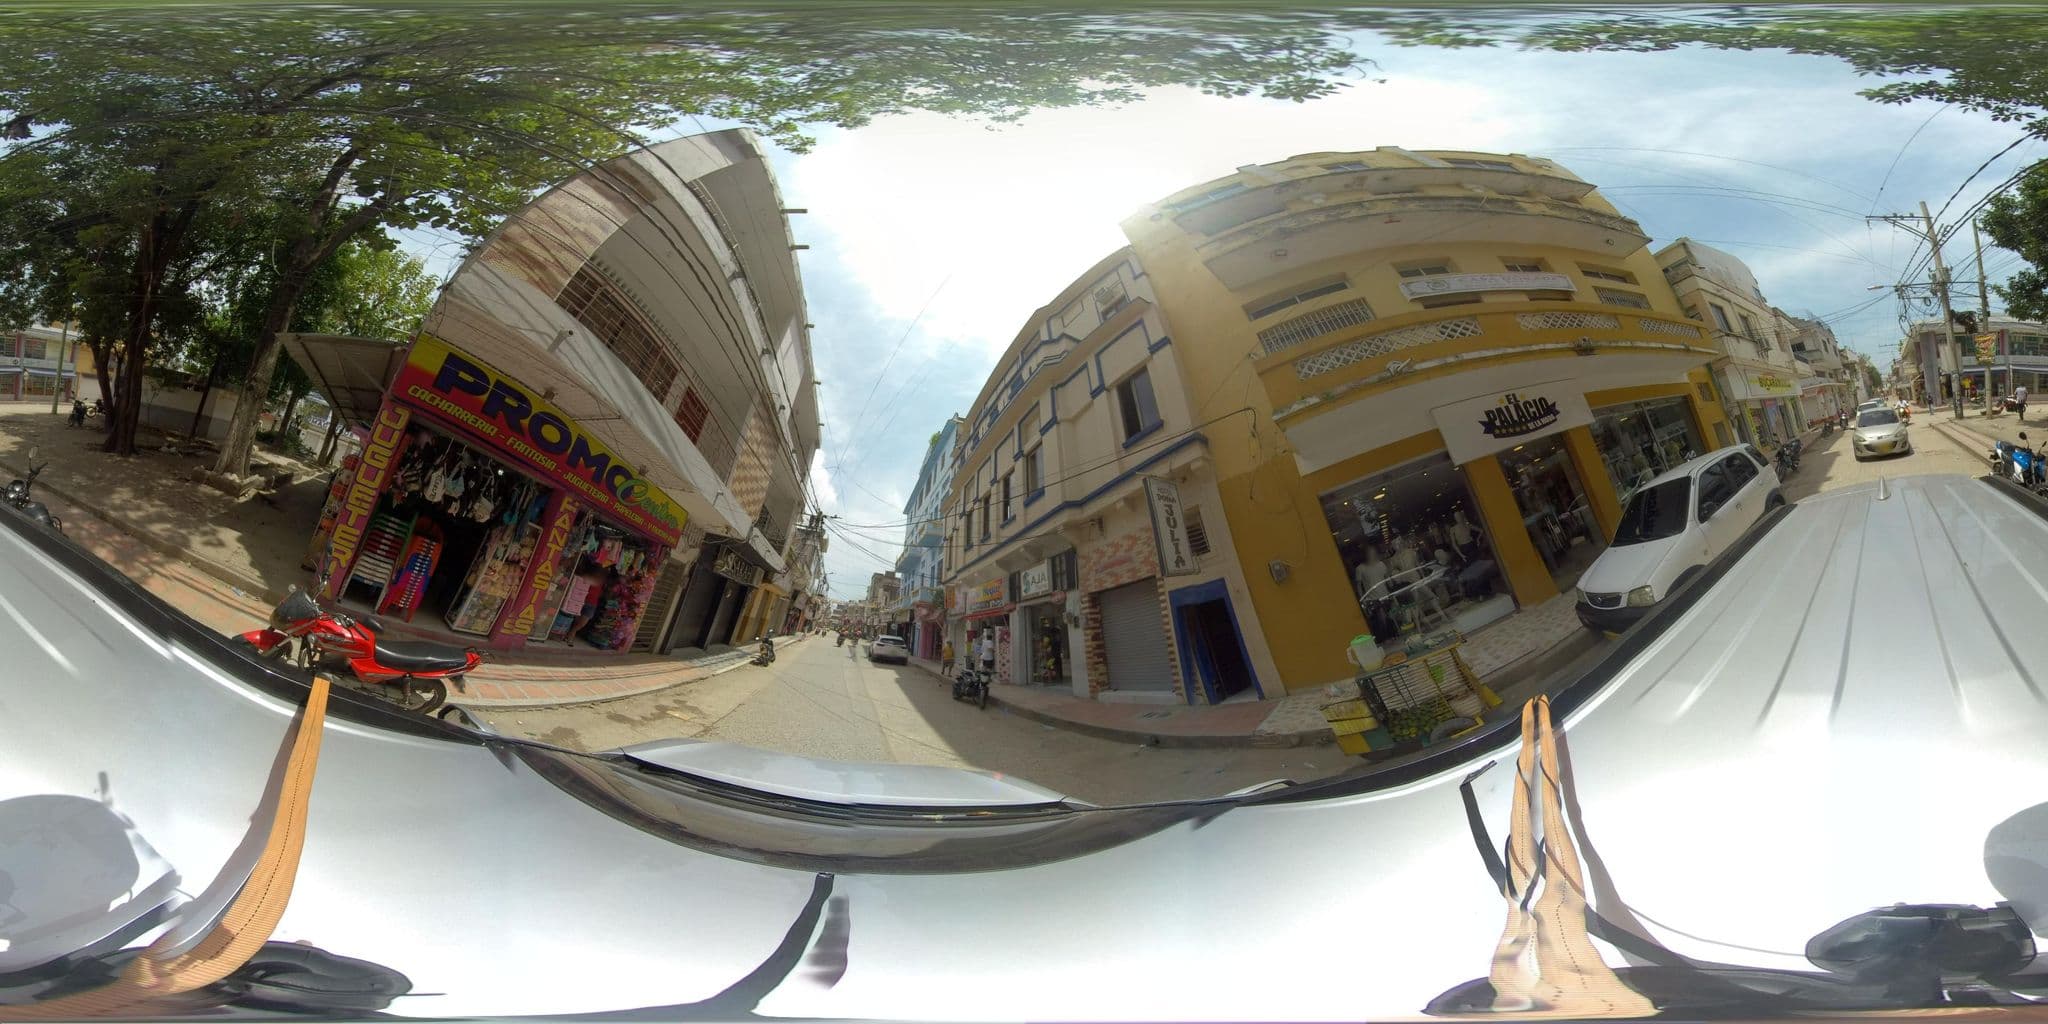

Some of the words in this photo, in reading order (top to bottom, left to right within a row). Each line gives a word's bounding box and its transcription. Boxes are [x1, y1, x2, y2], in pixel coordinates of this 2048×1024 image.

[407, 384, 498, 437] CACHARRERIA
[506, 436, 557, 471] FANTASIA
[563, 472, 610, 504] JUGUETERIA
[433, 352, 636, 504] PROMO
[1484, 397, 1550, 426] PALACIO
[1505, 393, 1520, 404] EL
[515, 496, 580, 636] FANTASIAS
[1163, 503, 1186, 569] JULIA
